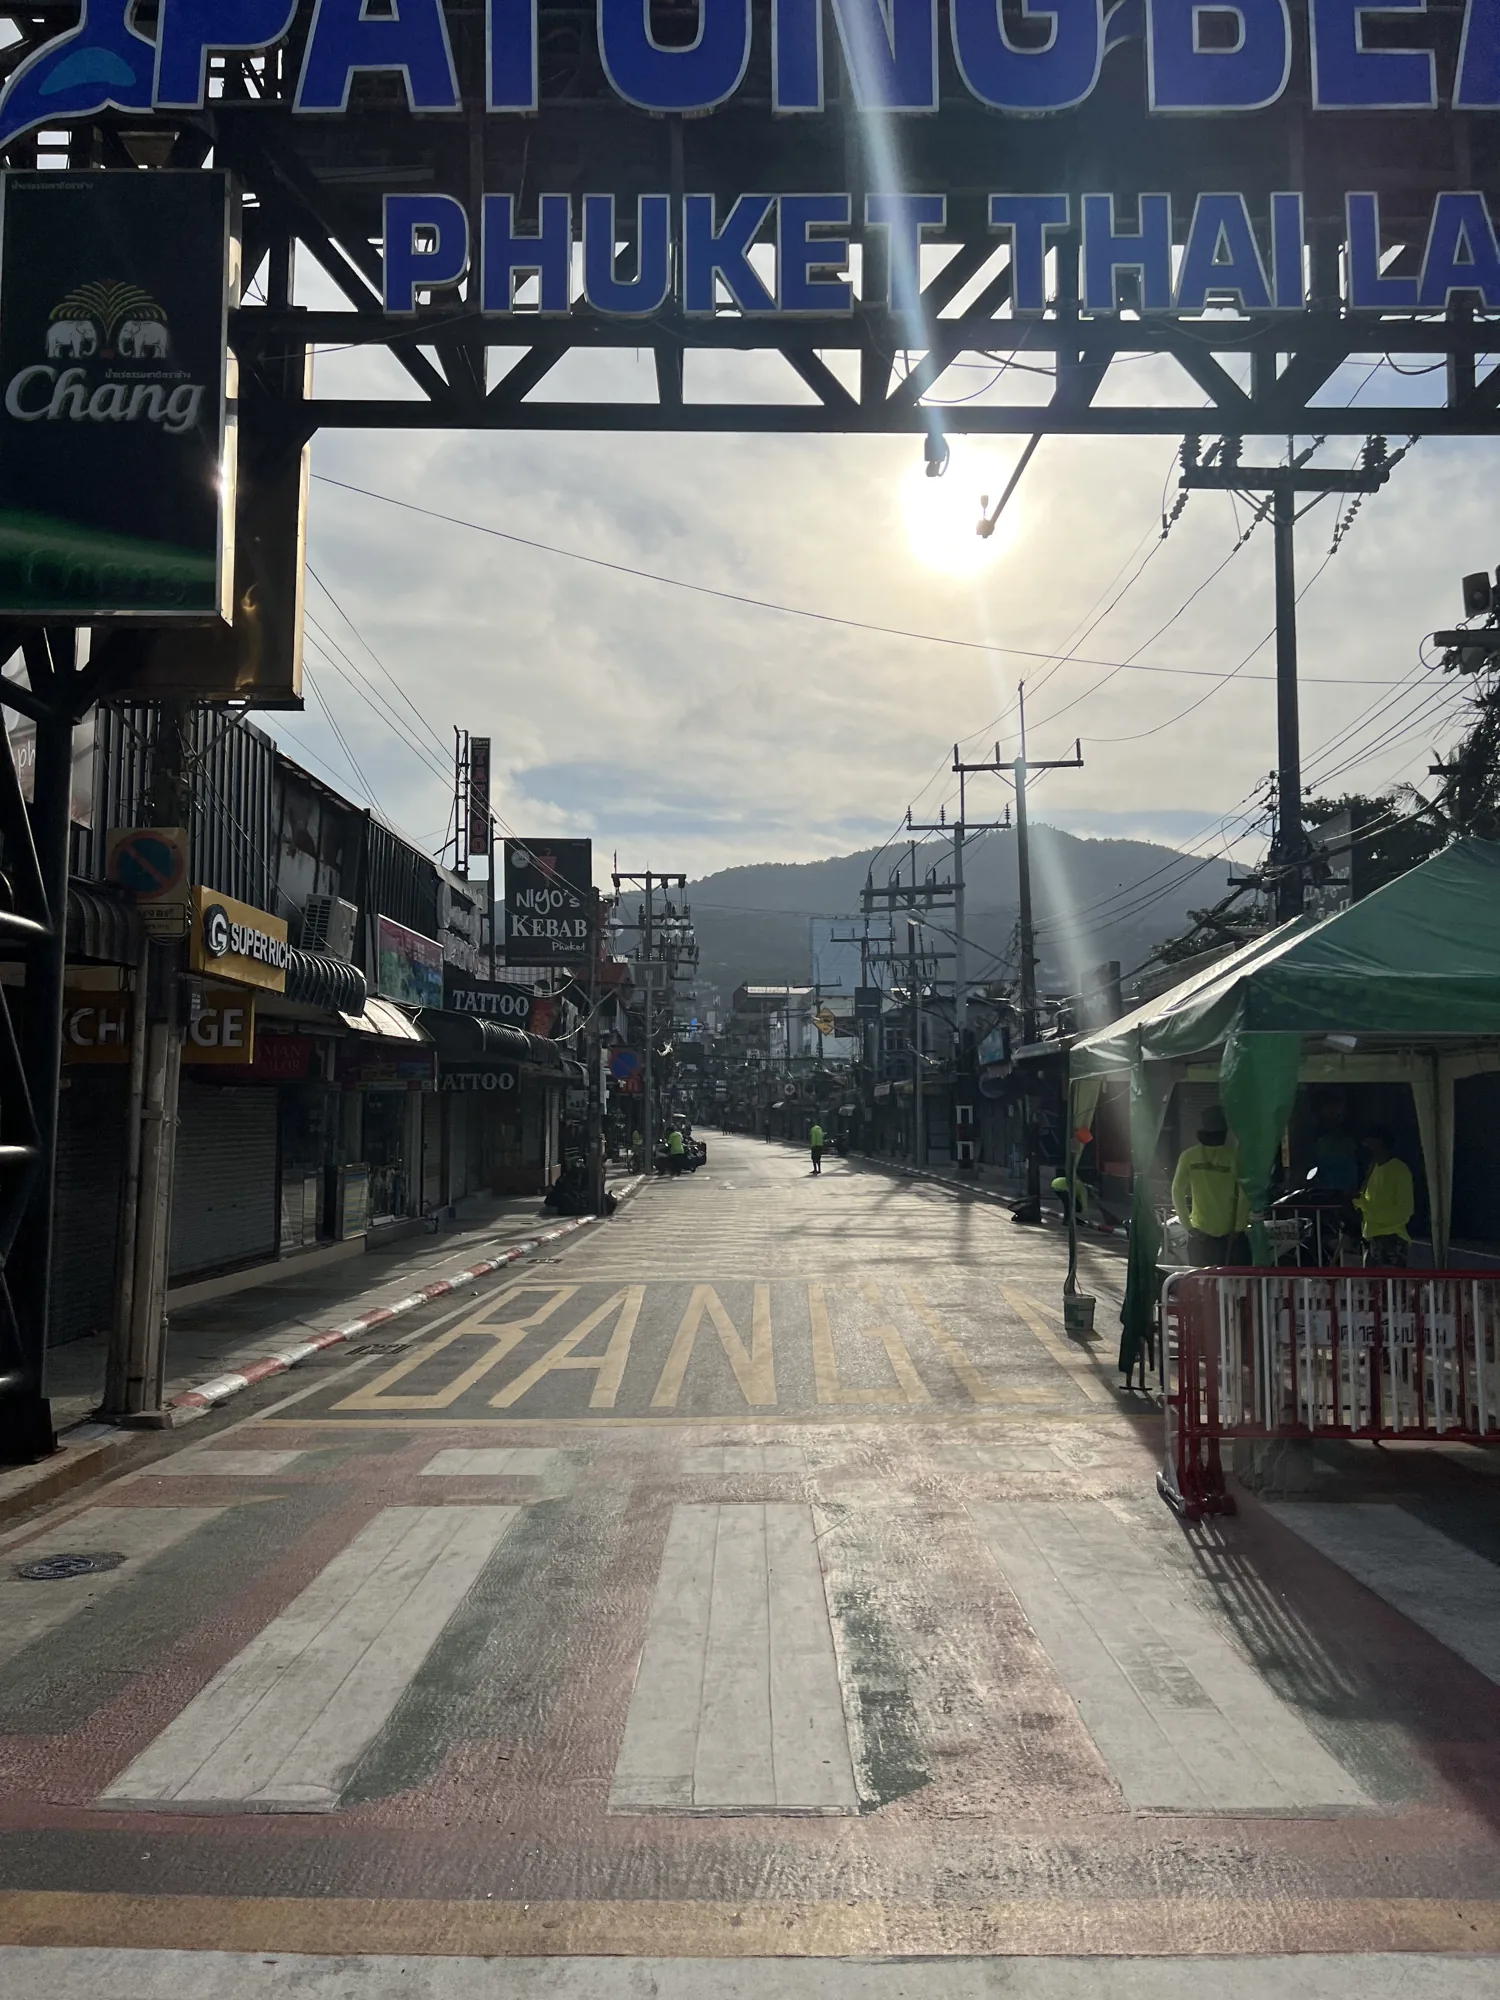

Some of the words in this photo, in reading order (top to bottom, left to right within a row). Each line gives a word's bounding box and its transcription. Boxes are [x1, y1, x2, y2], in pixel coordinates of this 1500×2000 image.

[382, 192, 947, 315] PHUKET
[5, 364, 206, 435] Chang
[510, 914, 588, 938] KEBAB
[231, 922, 268, 962] SUPER
[268, 936, 293, 970] RICH
[452, 989, 530, 1017] TATTOO
[441, 1071, 516, 1091] ATTOO
